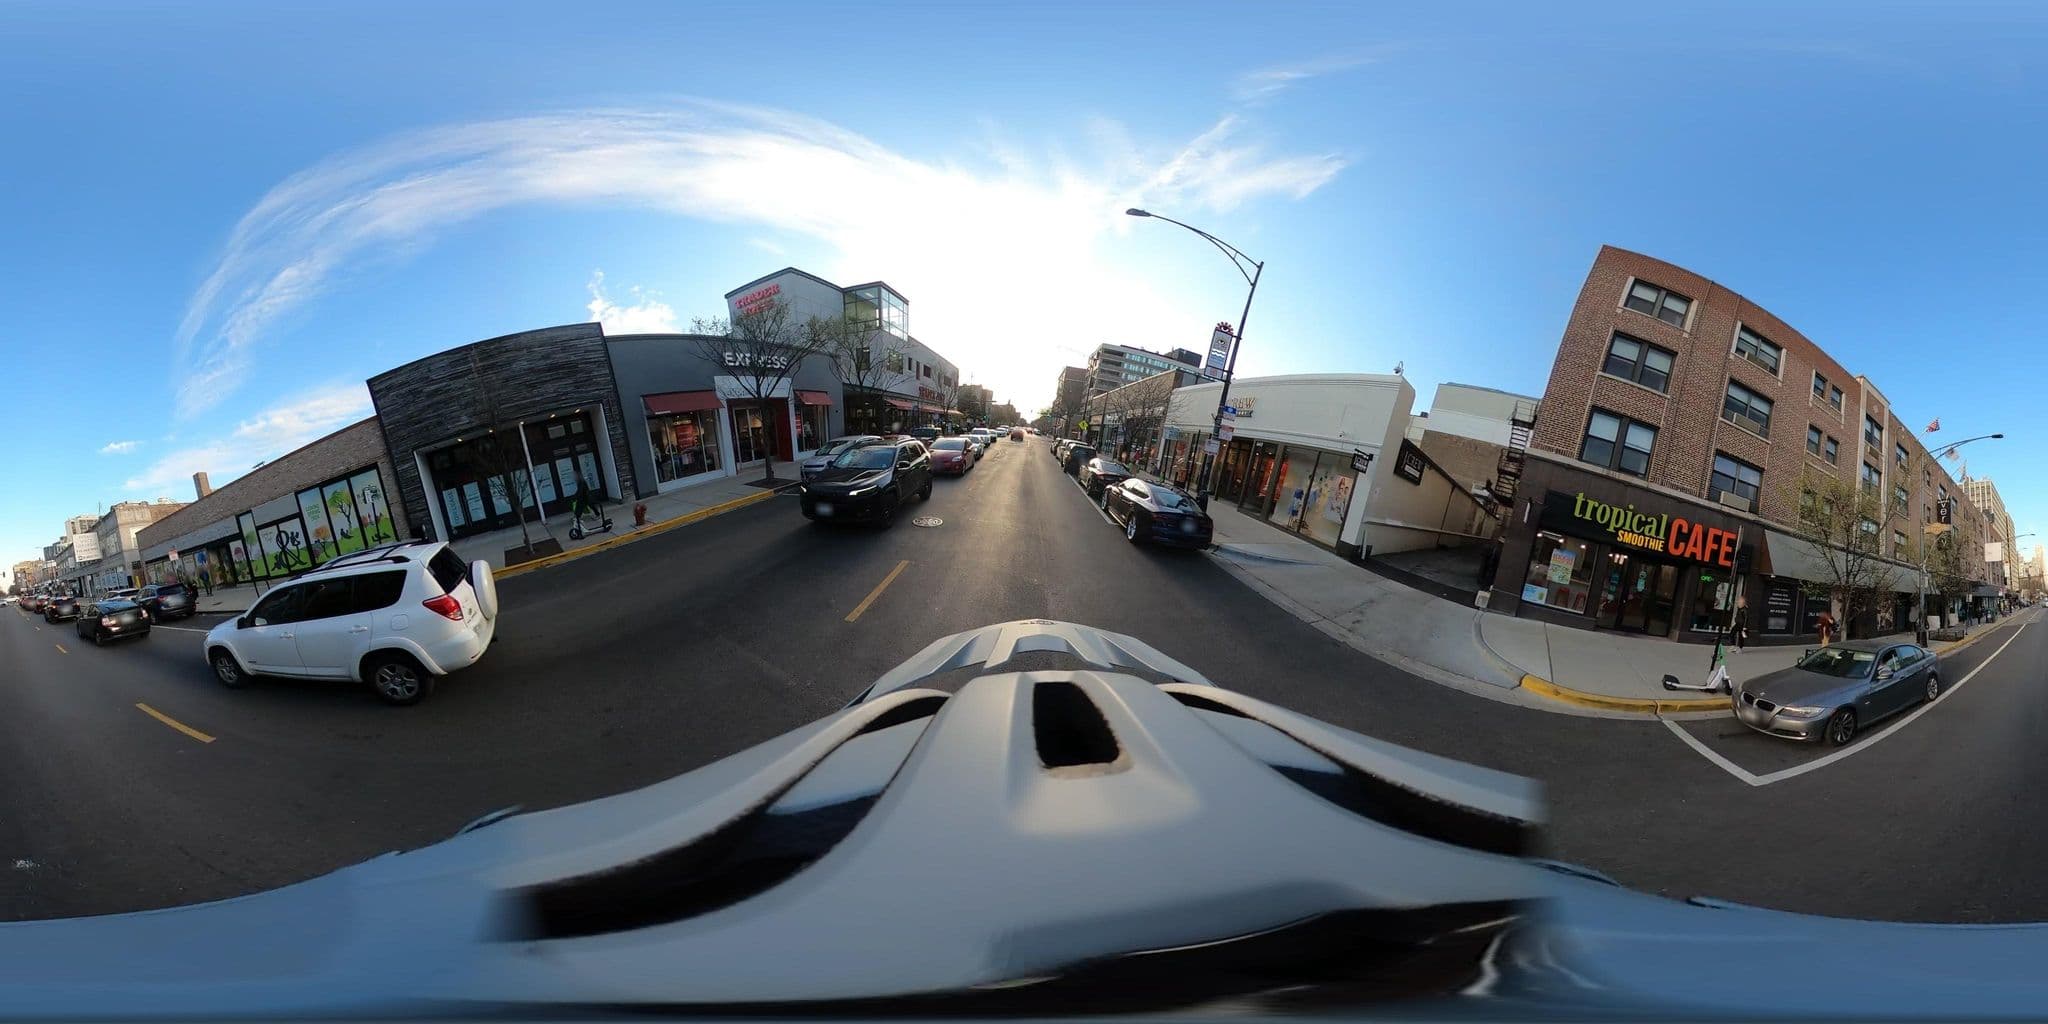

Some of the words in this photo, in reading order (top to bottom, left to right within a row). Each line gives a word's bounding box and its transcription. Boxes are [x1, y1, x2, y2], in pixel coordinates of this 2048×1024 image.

[735, 284, 780, 309] TRADER
[724, 352, 788, 369] EXPESS
[1574, 491, 1669, 540] tropical
[1617, 529, 1665, 552] SMOOTHIE
[1668, 517, 1737, 567] CAFE
